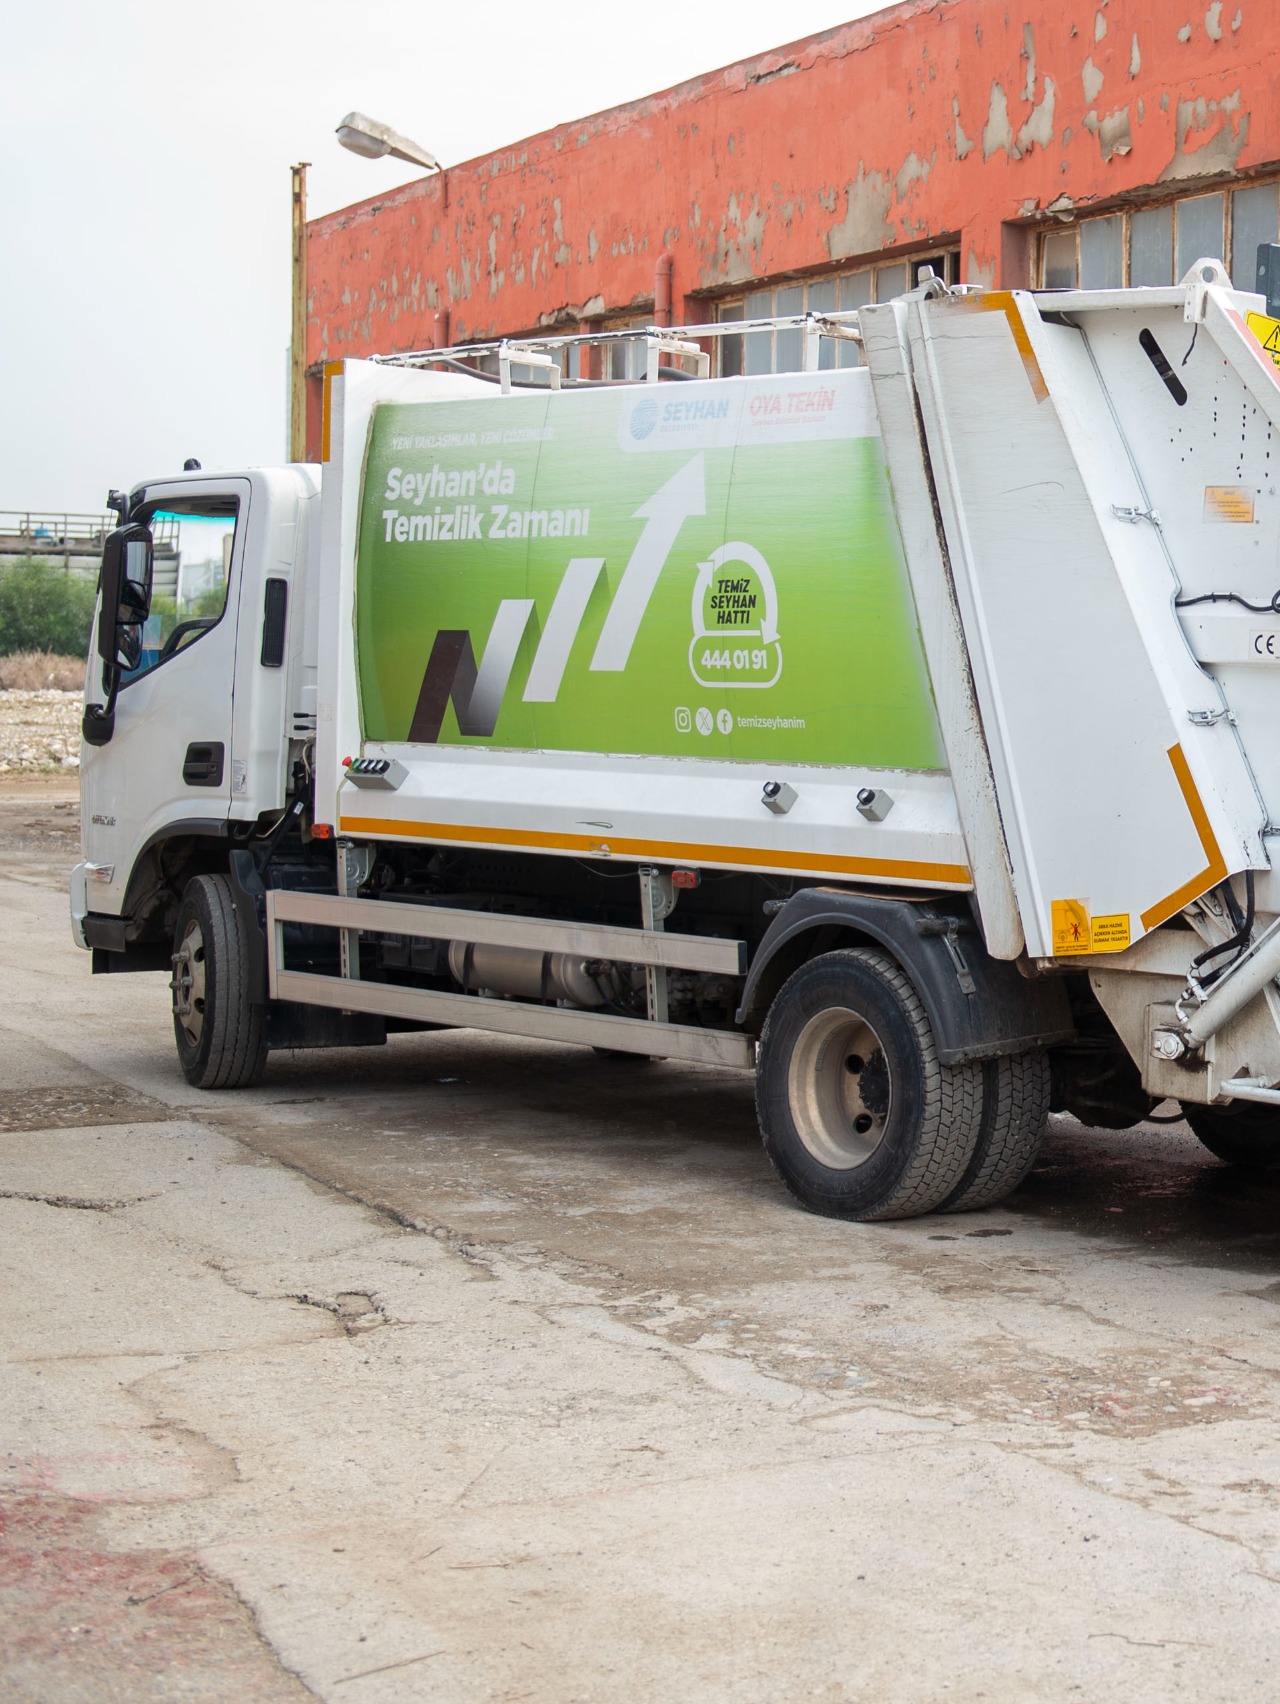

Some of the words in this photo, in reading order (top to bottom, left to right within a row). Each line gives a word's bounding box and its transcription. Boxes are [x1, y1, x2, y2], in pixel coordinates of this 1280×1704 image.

[662, 398, 730, 422] SEYHAN
[749, 393, 782, 417] OYA
[786, 386, 837, 413] TEKİN
[382, 505, 485, 543] Temizlik
[488, 505, 591, 539] Zamanı
[718, 578, 751, 593] TEMİZ
[710, 595, 757, 609] SEYHAN
[717, 610, 750, 624] HATTI
[701, 649, 732, 669] 444
[733, 649, 750, 669] 01
[751, 649, 768, 669] 91
[737, 716, 806, 731] temizseyhanim
